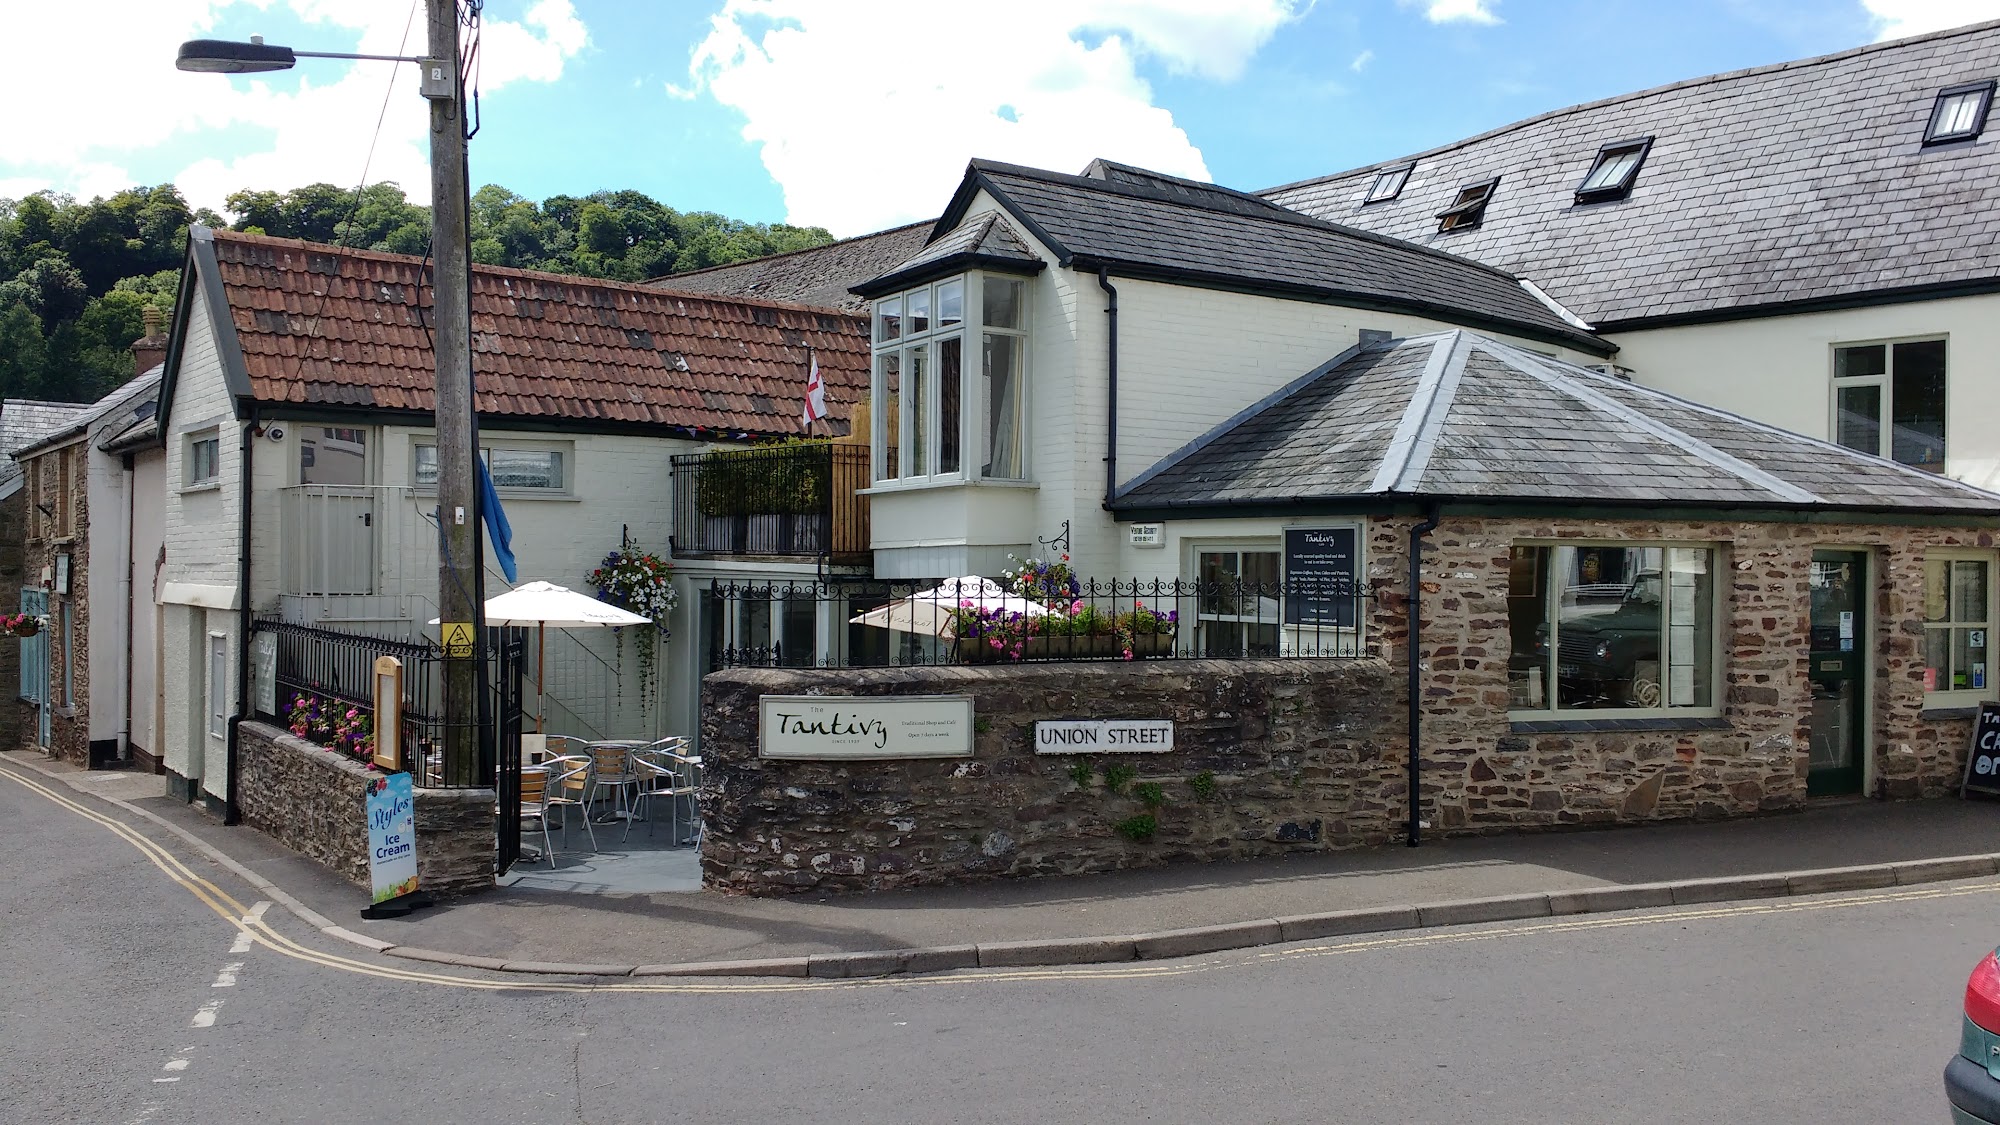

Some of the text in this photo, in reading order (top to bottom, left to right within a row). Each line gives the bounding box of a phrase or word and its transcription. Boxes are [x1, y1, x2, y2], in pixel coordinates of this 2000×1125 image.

[434, 70, 439, 78] 2
[776, 712, 887, 749] Tantivy
[1041, 728, 1169, 744] UNION STREET
[370, 797, 409, 830] Styles
[385, 834, 400, 846] Ice
[376, 843, 410, 859] Cream
